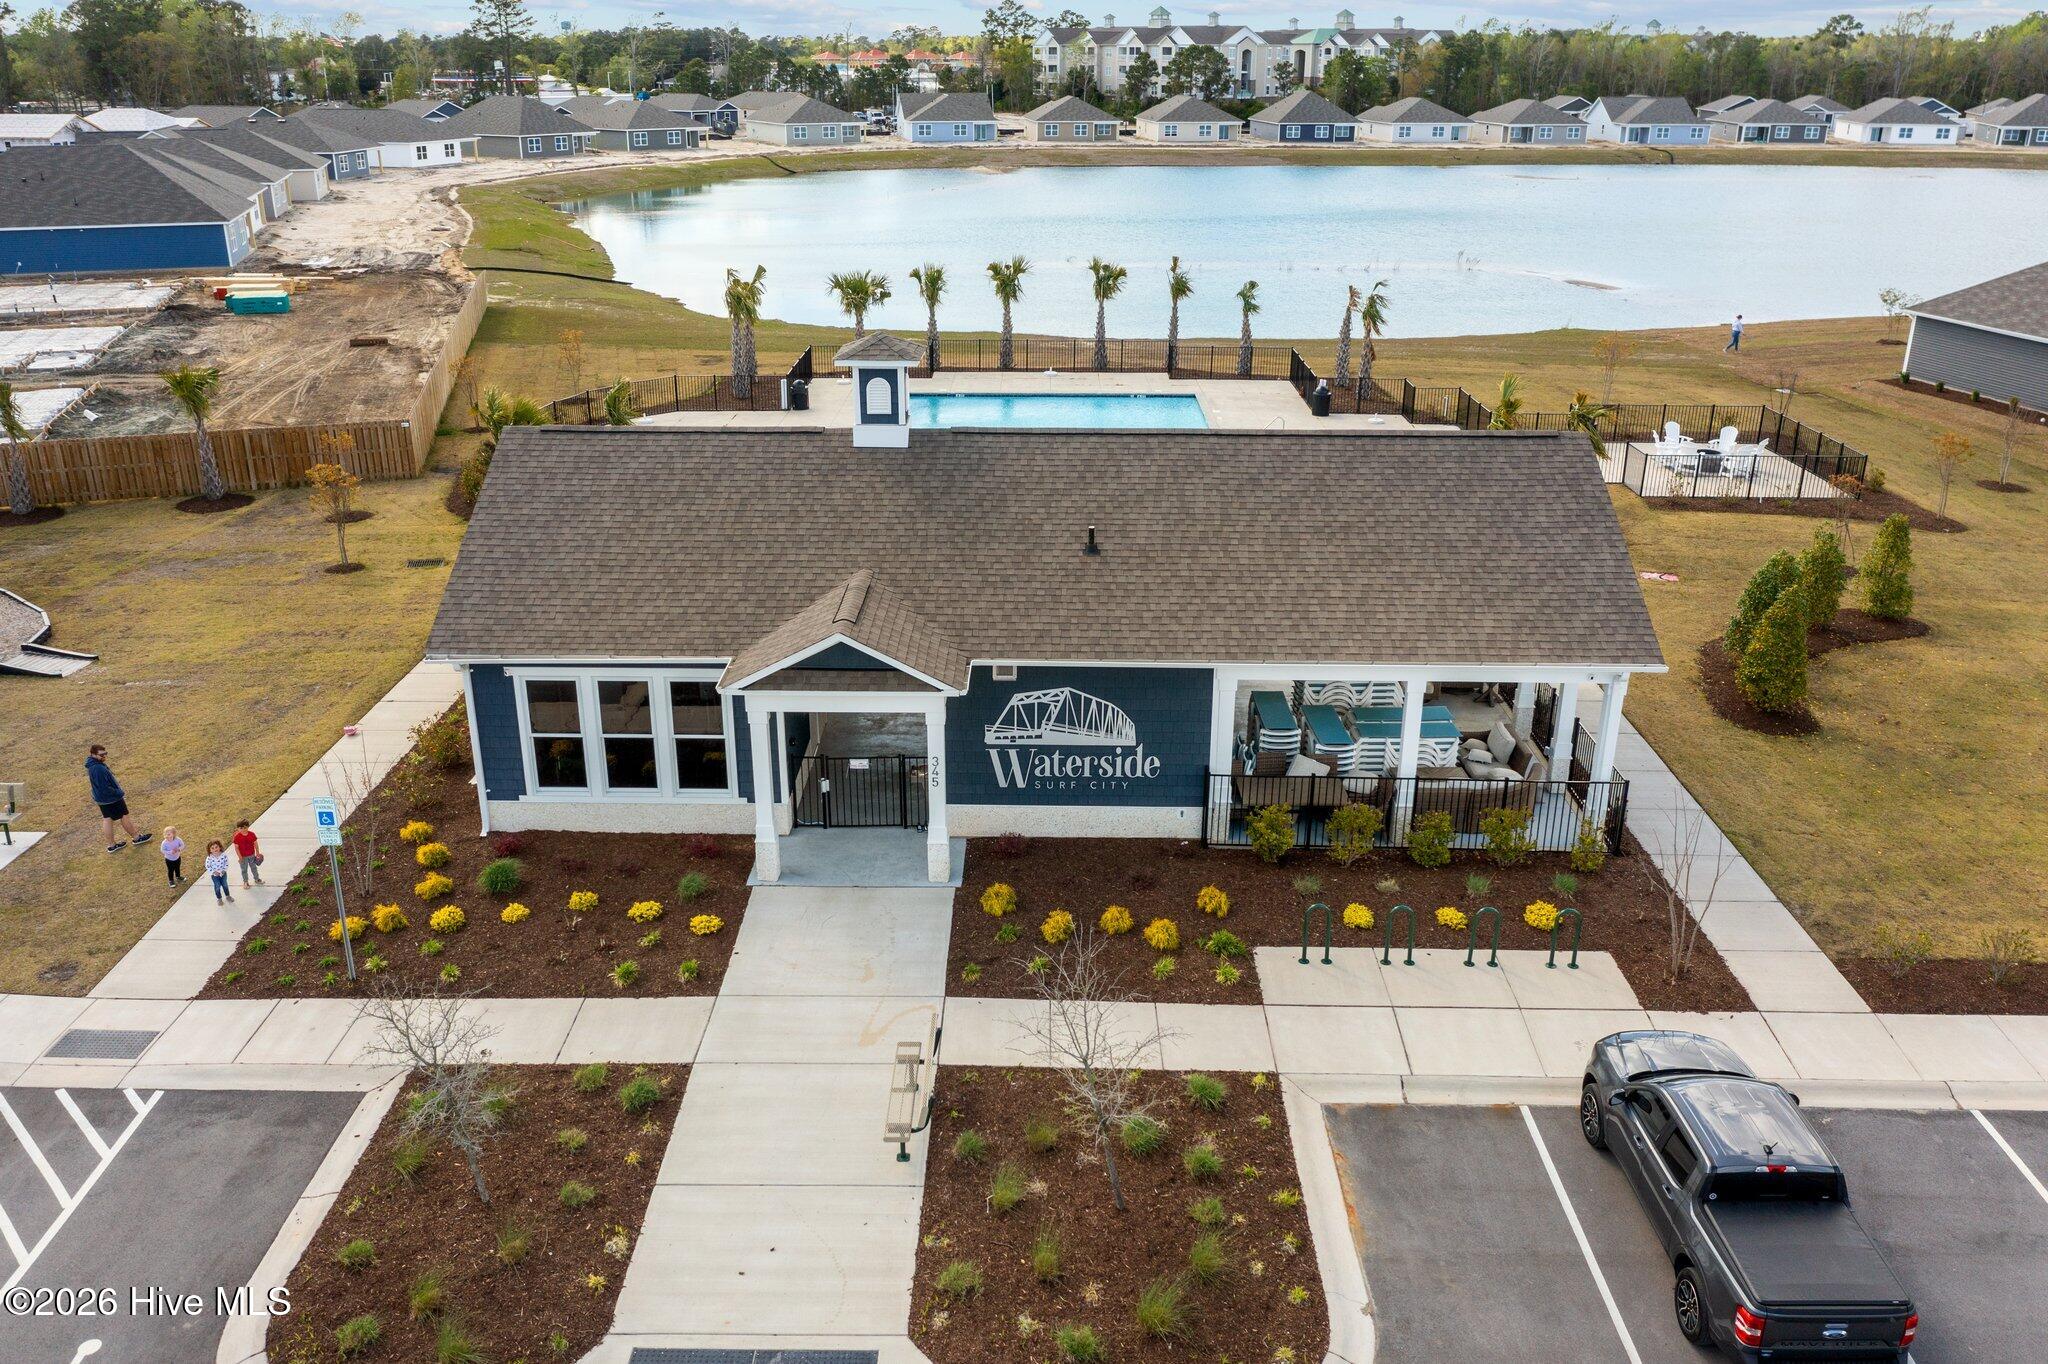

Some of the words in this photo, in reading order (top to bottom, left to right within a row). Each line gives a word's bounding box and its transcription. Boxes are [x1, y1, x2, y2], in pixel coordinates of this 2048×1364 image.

[931, 756, 939, 788] 345
[985, 743, 1160, 789] Waterside
[1034, 780, 1077, 790] SURF
[1090, 780, 1129, 790] CITY
